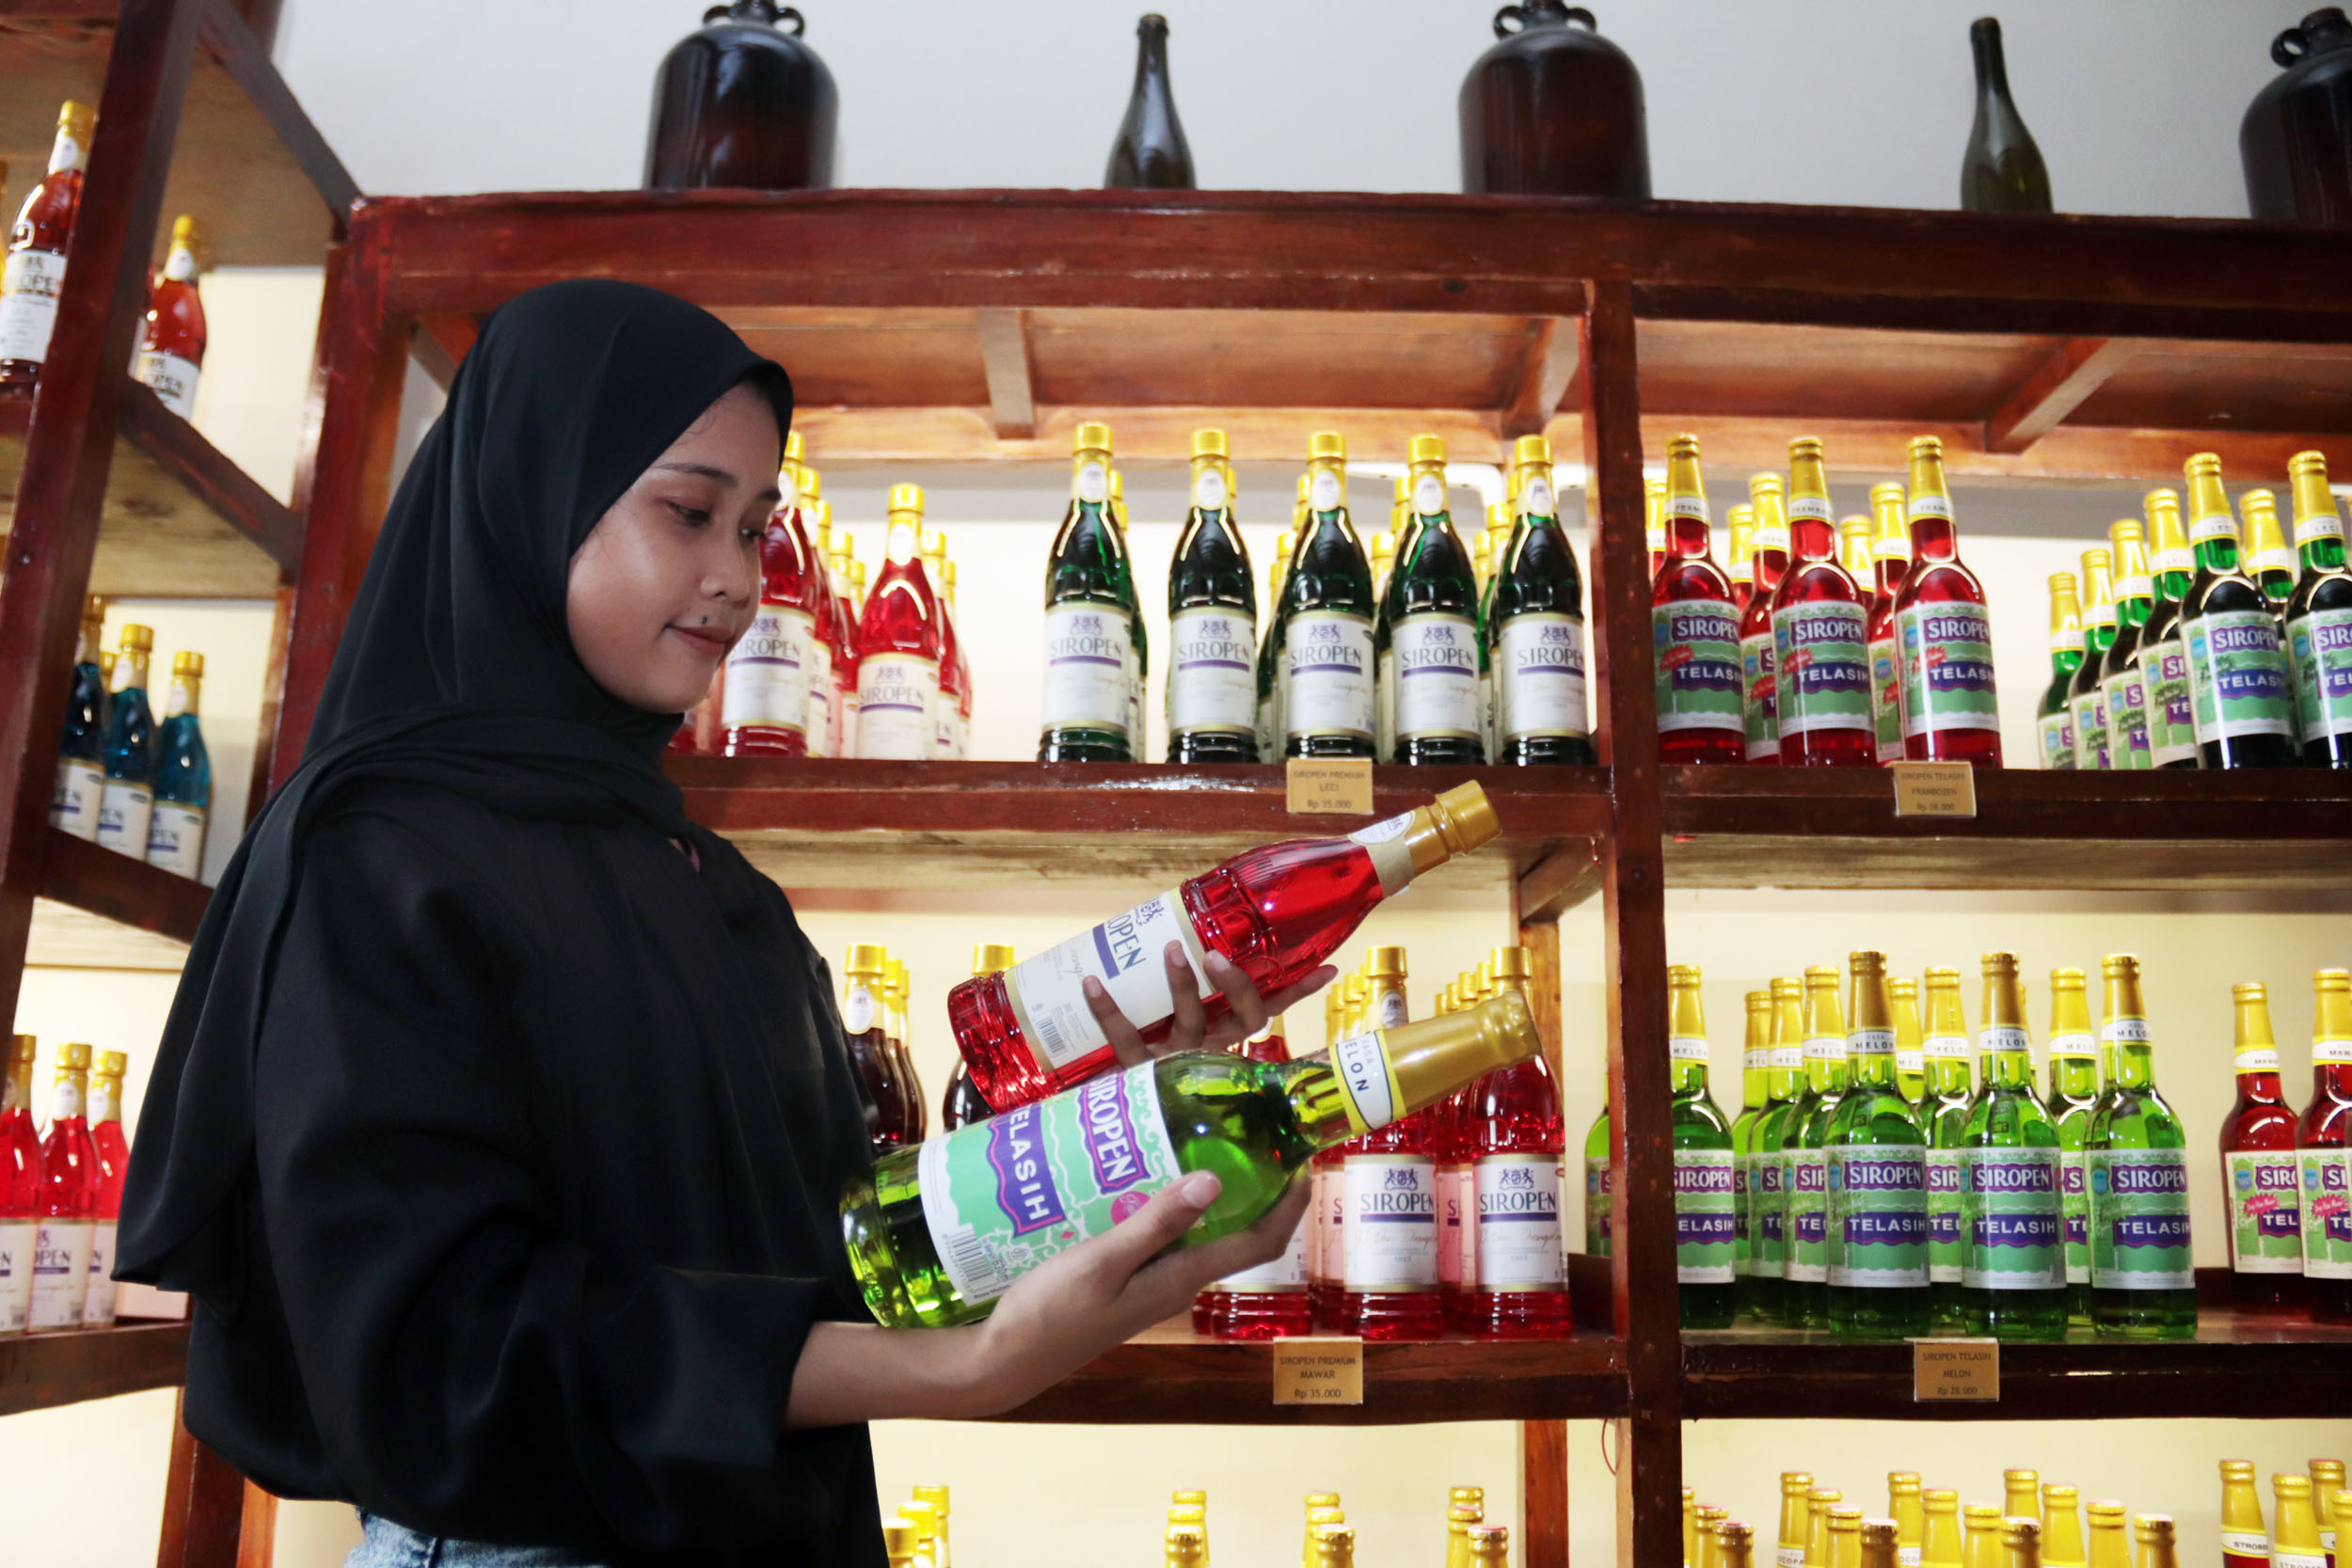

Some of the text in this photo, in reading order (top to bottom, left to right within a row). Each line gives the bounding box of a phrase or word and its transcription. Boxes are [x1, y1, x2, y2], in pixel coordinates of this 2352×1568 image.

[1795, 621, 1863, 641] SIROPEN
[2215, 629, 2278, 648] SIROPE
[1050, 637, 1122, 657] SIROPEN
[1178, 641, 1250, 661] SIROPEN
[1291, 645, 1361, 669] SIROPEN
[1402, 647, 1474, 669] SIROPEN
[2219, 673, 2280, 689] TELAS
[859, 685, 924, 704] SIROPEN
[1319, 782, 1340, 792] LECI
[1106, 914, 1147, 971] OPEN
[2118, 1030, 2151, 1039] MELO
[1812, 1047, 1841, 1056] MELO
[1344, 1041, 1370, 1092] ELON
[1009, 1107, 1050, 1221] ELASIH
[1850, 1165, 1921, 1185] SIROPEN
[1976, 1167, 2050, 1187] SIROPEN
[2117, 1169, 2185, 1189] SIROPEN
[1360, 1192, 1435, 1212] SIROPEN
[1479, 1191, 1557, 1213] SIROPEN
[1677, 1219, 1734, 1232] ELASIH
[1849, 1218, 1927, 1232] TELASIH
[1977, 1220, 2056, 1234] TELASIH
[1300, 1370, 1336, 1379] MAWAR
[1943, 1369, 1971, 1378] MELON
[1295, 1387, 1342, 1400] Rp 35.000
